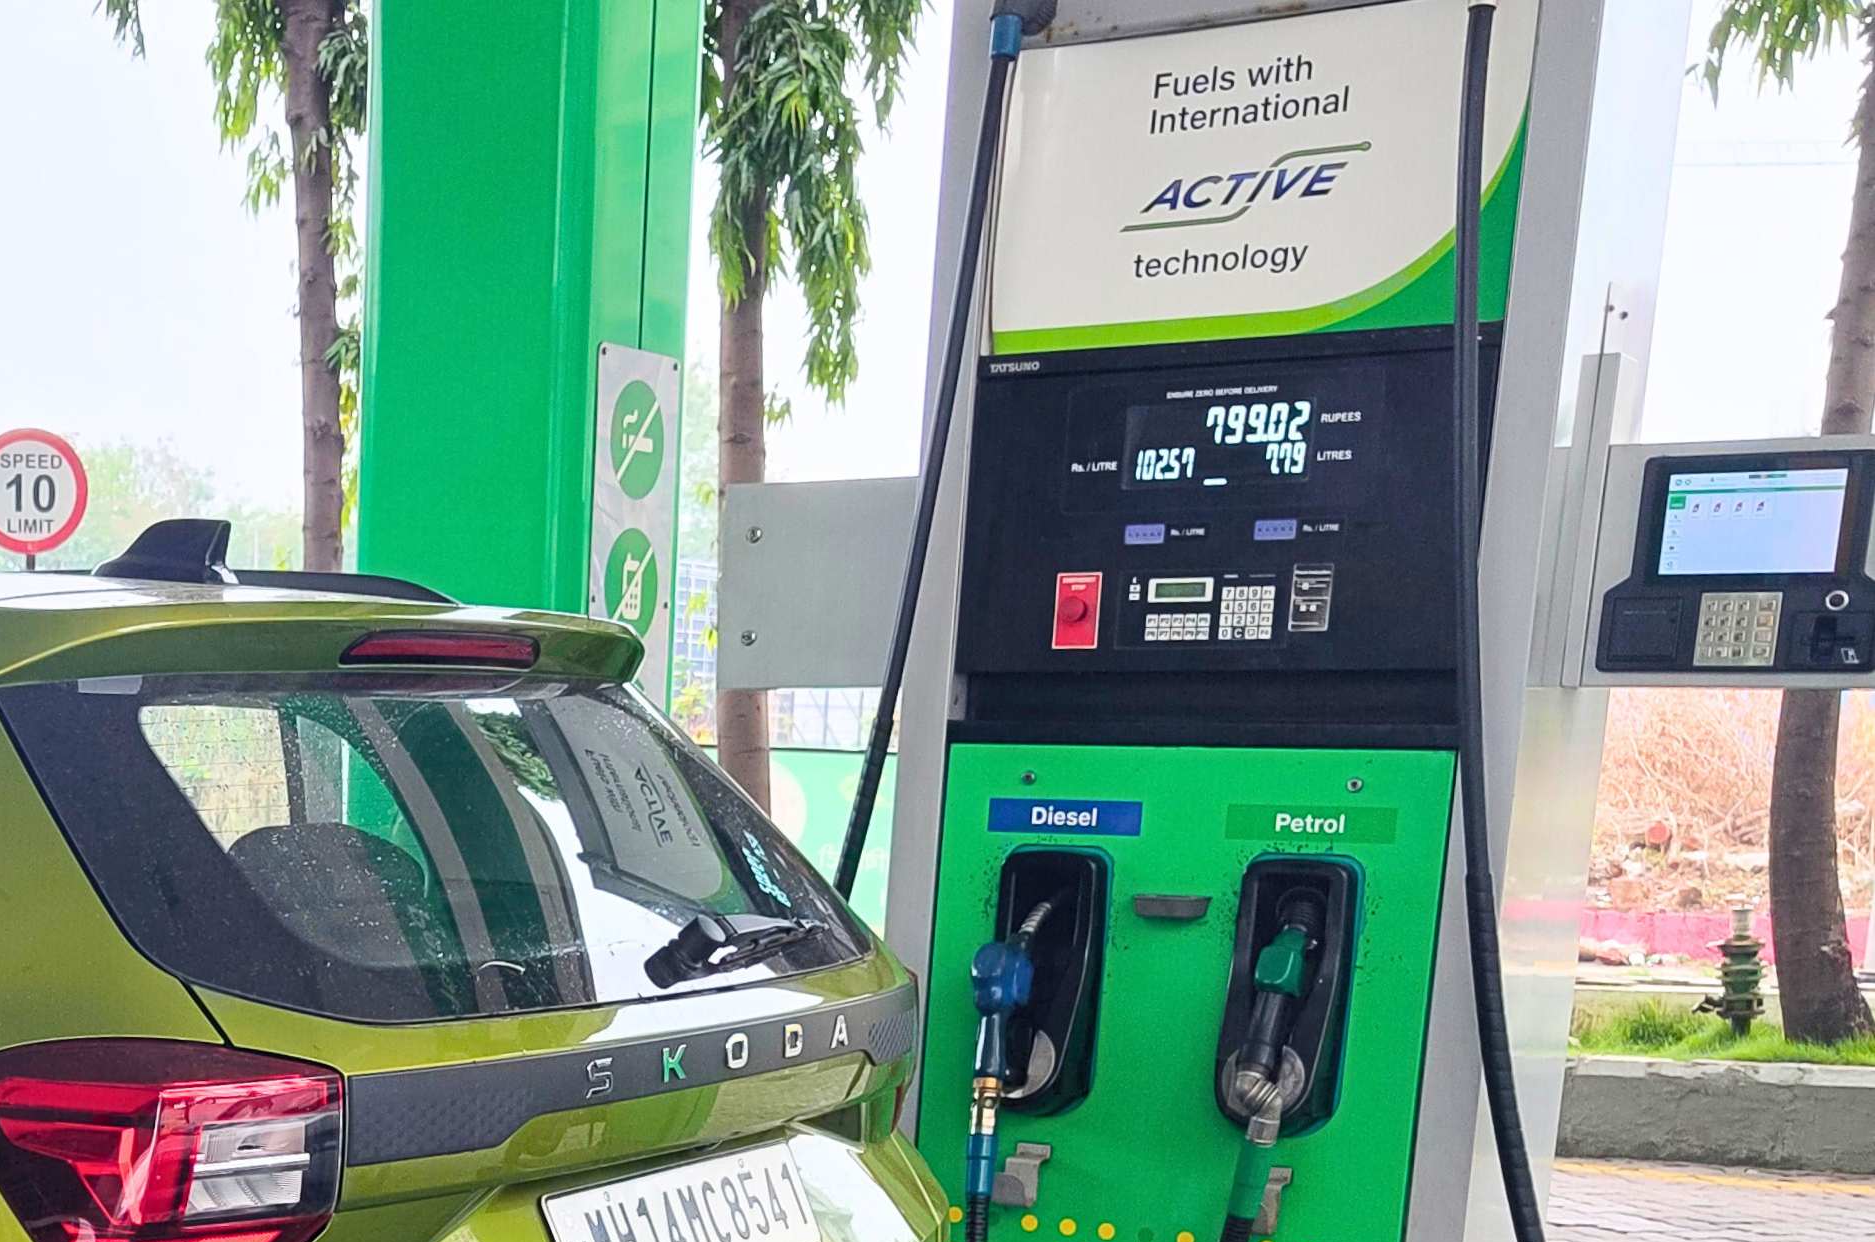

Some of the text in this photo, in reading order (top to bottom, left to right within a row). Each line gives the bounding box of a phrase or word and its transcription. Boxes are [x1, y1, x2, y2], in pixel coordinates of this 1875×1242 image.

[1153, 53, 1313, 99] Fuels with
[1149, 86, 1350, 134] International
[1140, 161, 1348, 213] ACTIVE
[1133, 243, 1309, 278] technology
[1320, 411, 1362, 423] RUPEES
[0, 453, 63, 470] SPEED
[1091, 461, 1118, 472] LITRE
[1316, 450, 1353, 462] LITRES
[5, 473, 56, 513] 10
[7, 518, 54, 534] LIMIT
[1030, 806, 1098, 828] Diesel
[1275, 814, 1346, 835] Petrol
[586, 1014, 849, 1100] SKODA
